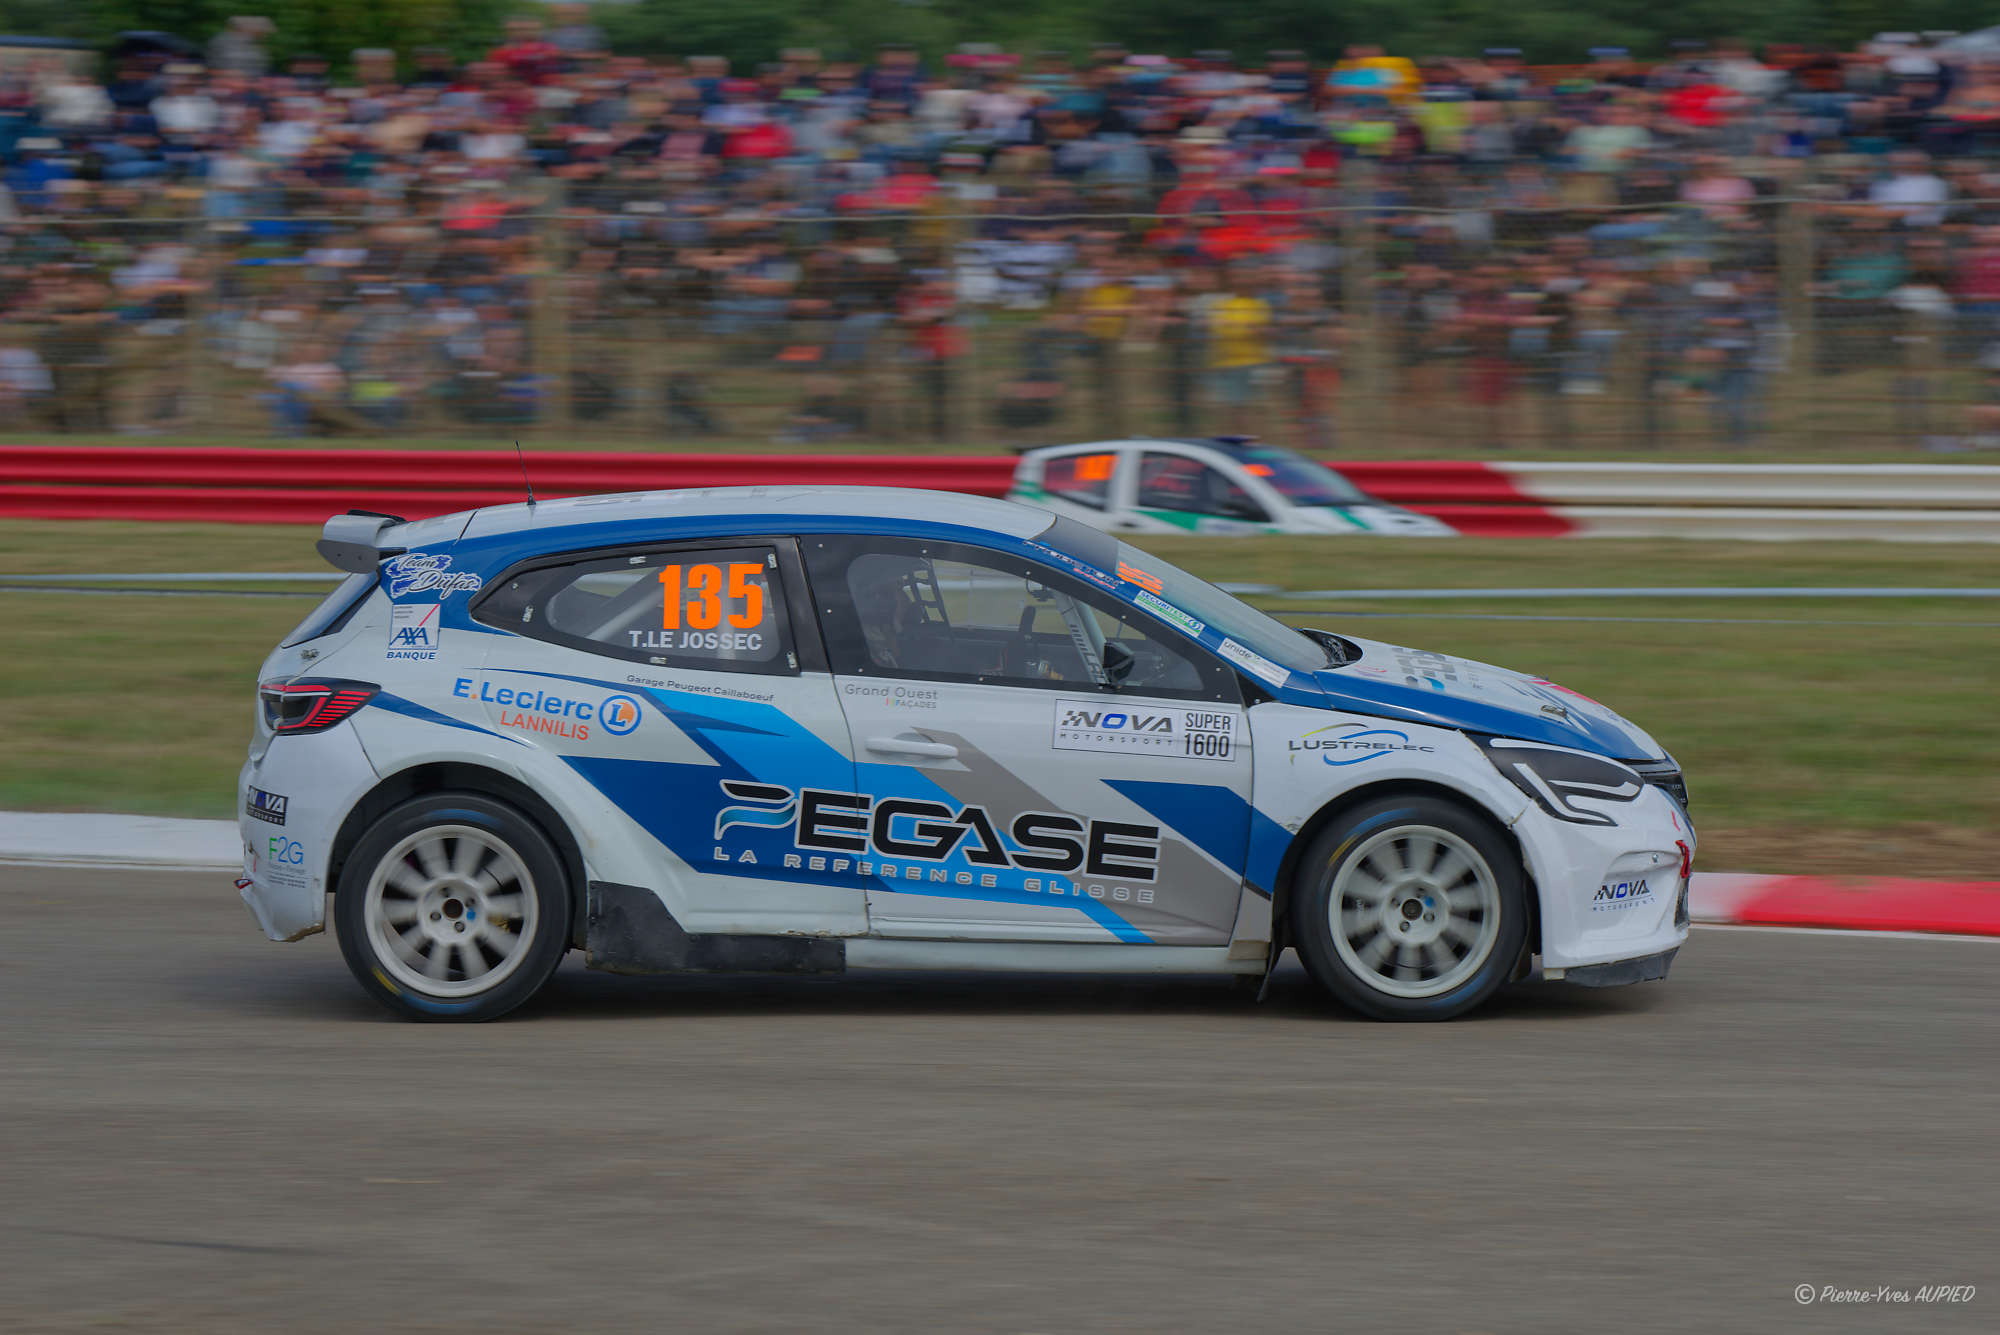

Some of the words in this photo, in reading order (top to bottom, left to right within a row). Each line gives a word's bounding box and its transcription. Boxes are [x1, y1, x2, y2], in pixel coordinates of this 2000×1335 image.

[395, 553, 438, 571] Team
[658, 563, 764, 630] 135
[389, 627, 429, 645] AXA
[629, 630, 674, 648] T.LE
[679, 631, 762, 650] JOSSEC
[386, 651, 436, 660] BANQUE
[626, 674, 665, 687] Garage
[667, 680, 711, 694] Peugeot
[845, 684, 889, 697] Grand
[895, 686, 938, 699] Ouest
[453, 677, 594, 721] E.Leclerc
[500, 711, 590, 742] LANNILIS
[1061, 710, 1173, 733] NOVA
[1185, 712, 1231, 731] SUPER
[1060, 733, 1173, 746] MOTORSPORT
[1183, 732, 1230, 758] 1600
[1289, 740, 1435, 753] LUSTRELEC
[714, 778, 1161, 884] PEGASE
[269, 836, 304, 865] F2G
[714, 847, 757, 864] LA
[784, 854, 998, 888] REFERENCE
[1024, 878, 1155, 904] GLISSE
[1593, 879, 1650, 900] NOVA
